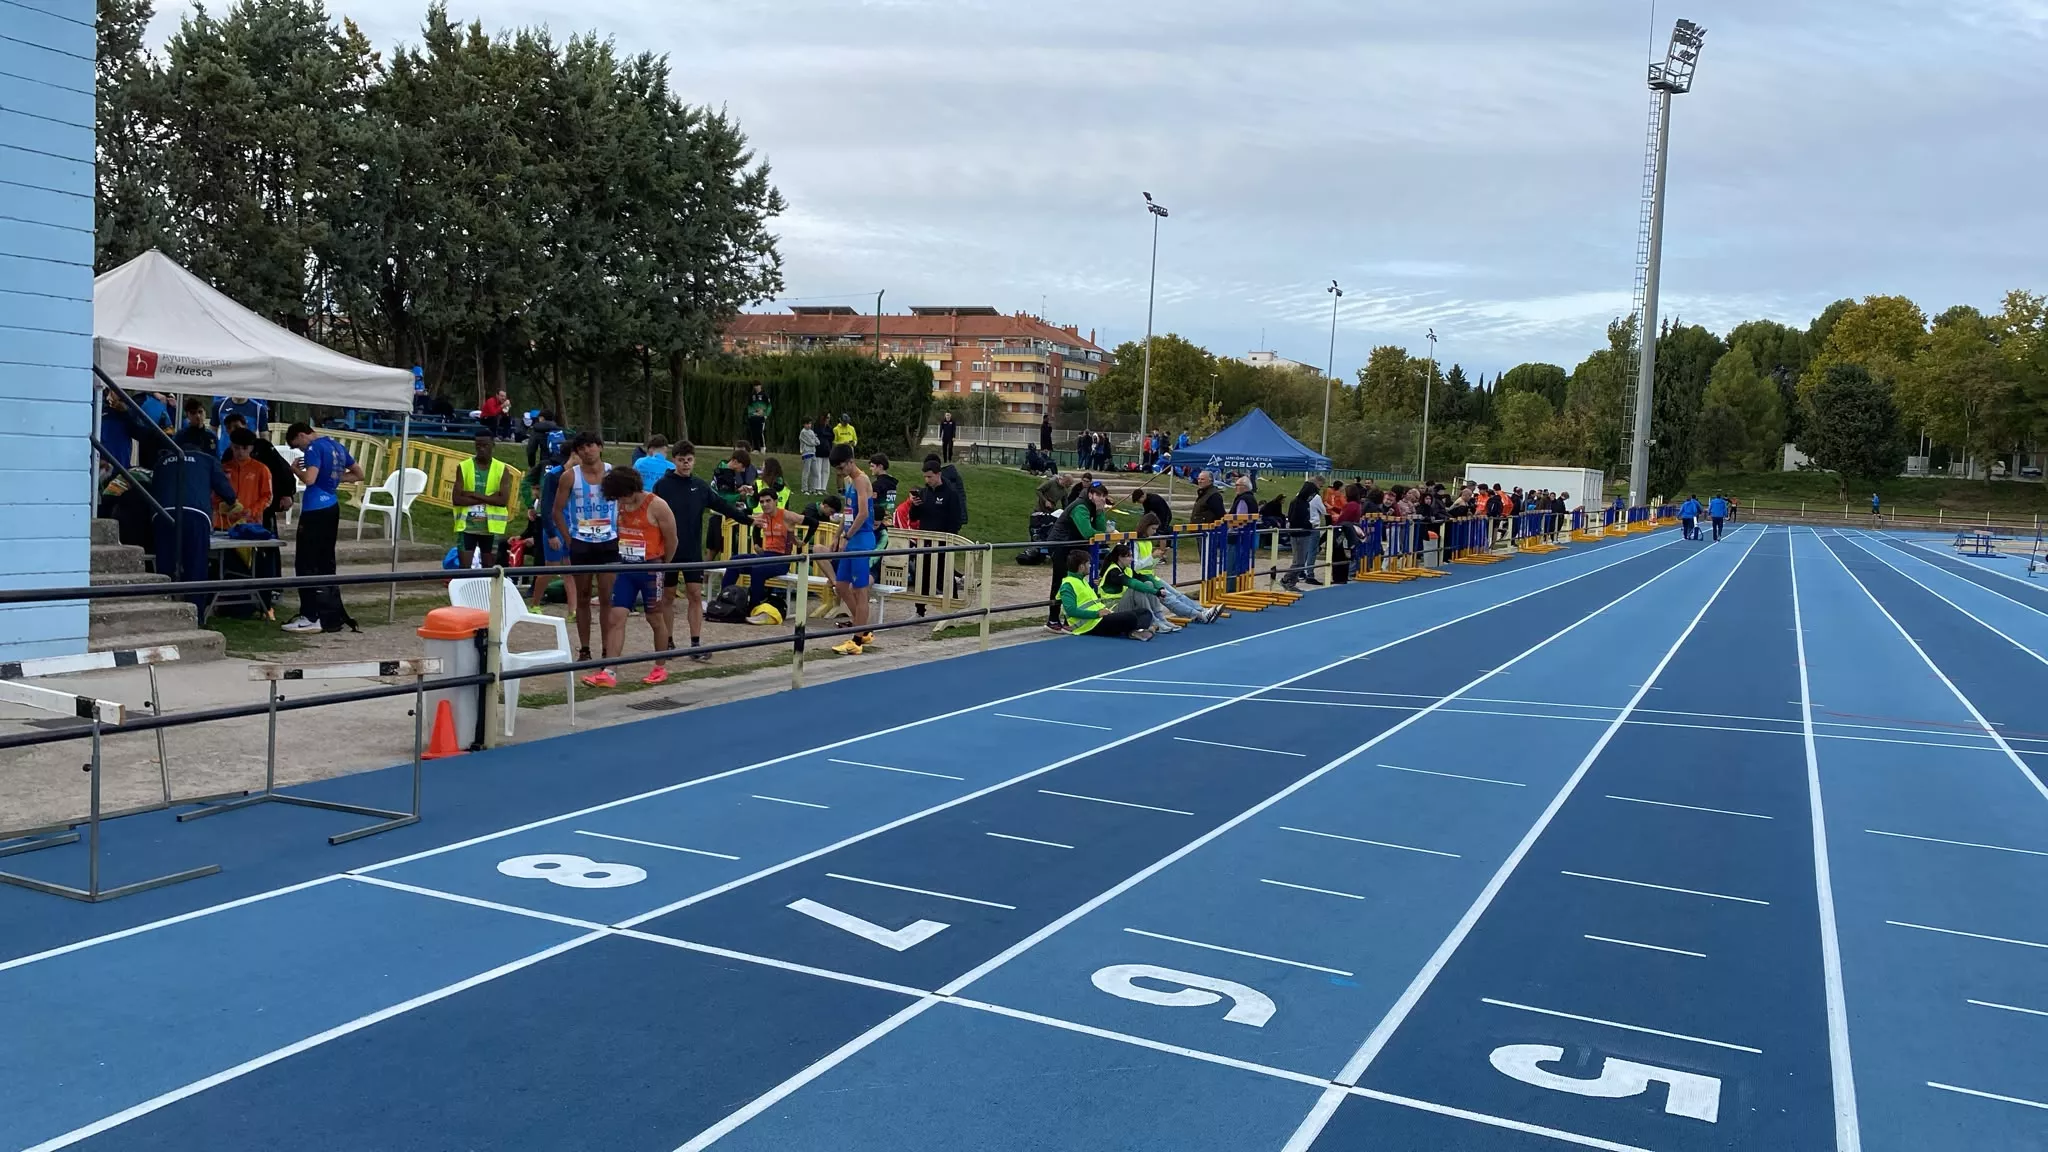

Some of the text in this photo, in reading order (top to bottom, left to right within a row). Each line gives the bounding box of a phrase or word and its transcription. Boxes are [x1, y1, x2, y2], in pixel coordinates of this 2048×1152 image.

[162, 353, 232, 368] Ayuntamiento
[159, 364, 213, 377] de Huesca
[1224, 461, 1274, 469] COSLADA
[590, 526, 601, 534] 16
[625, 547, 634, 555] 11
[497, 854, 647, 888] 8
[785, 898, 951, 952] 7
[1091, 964, 1277, 1028] 6
[1490, 1044, 1721, 1123] 5
